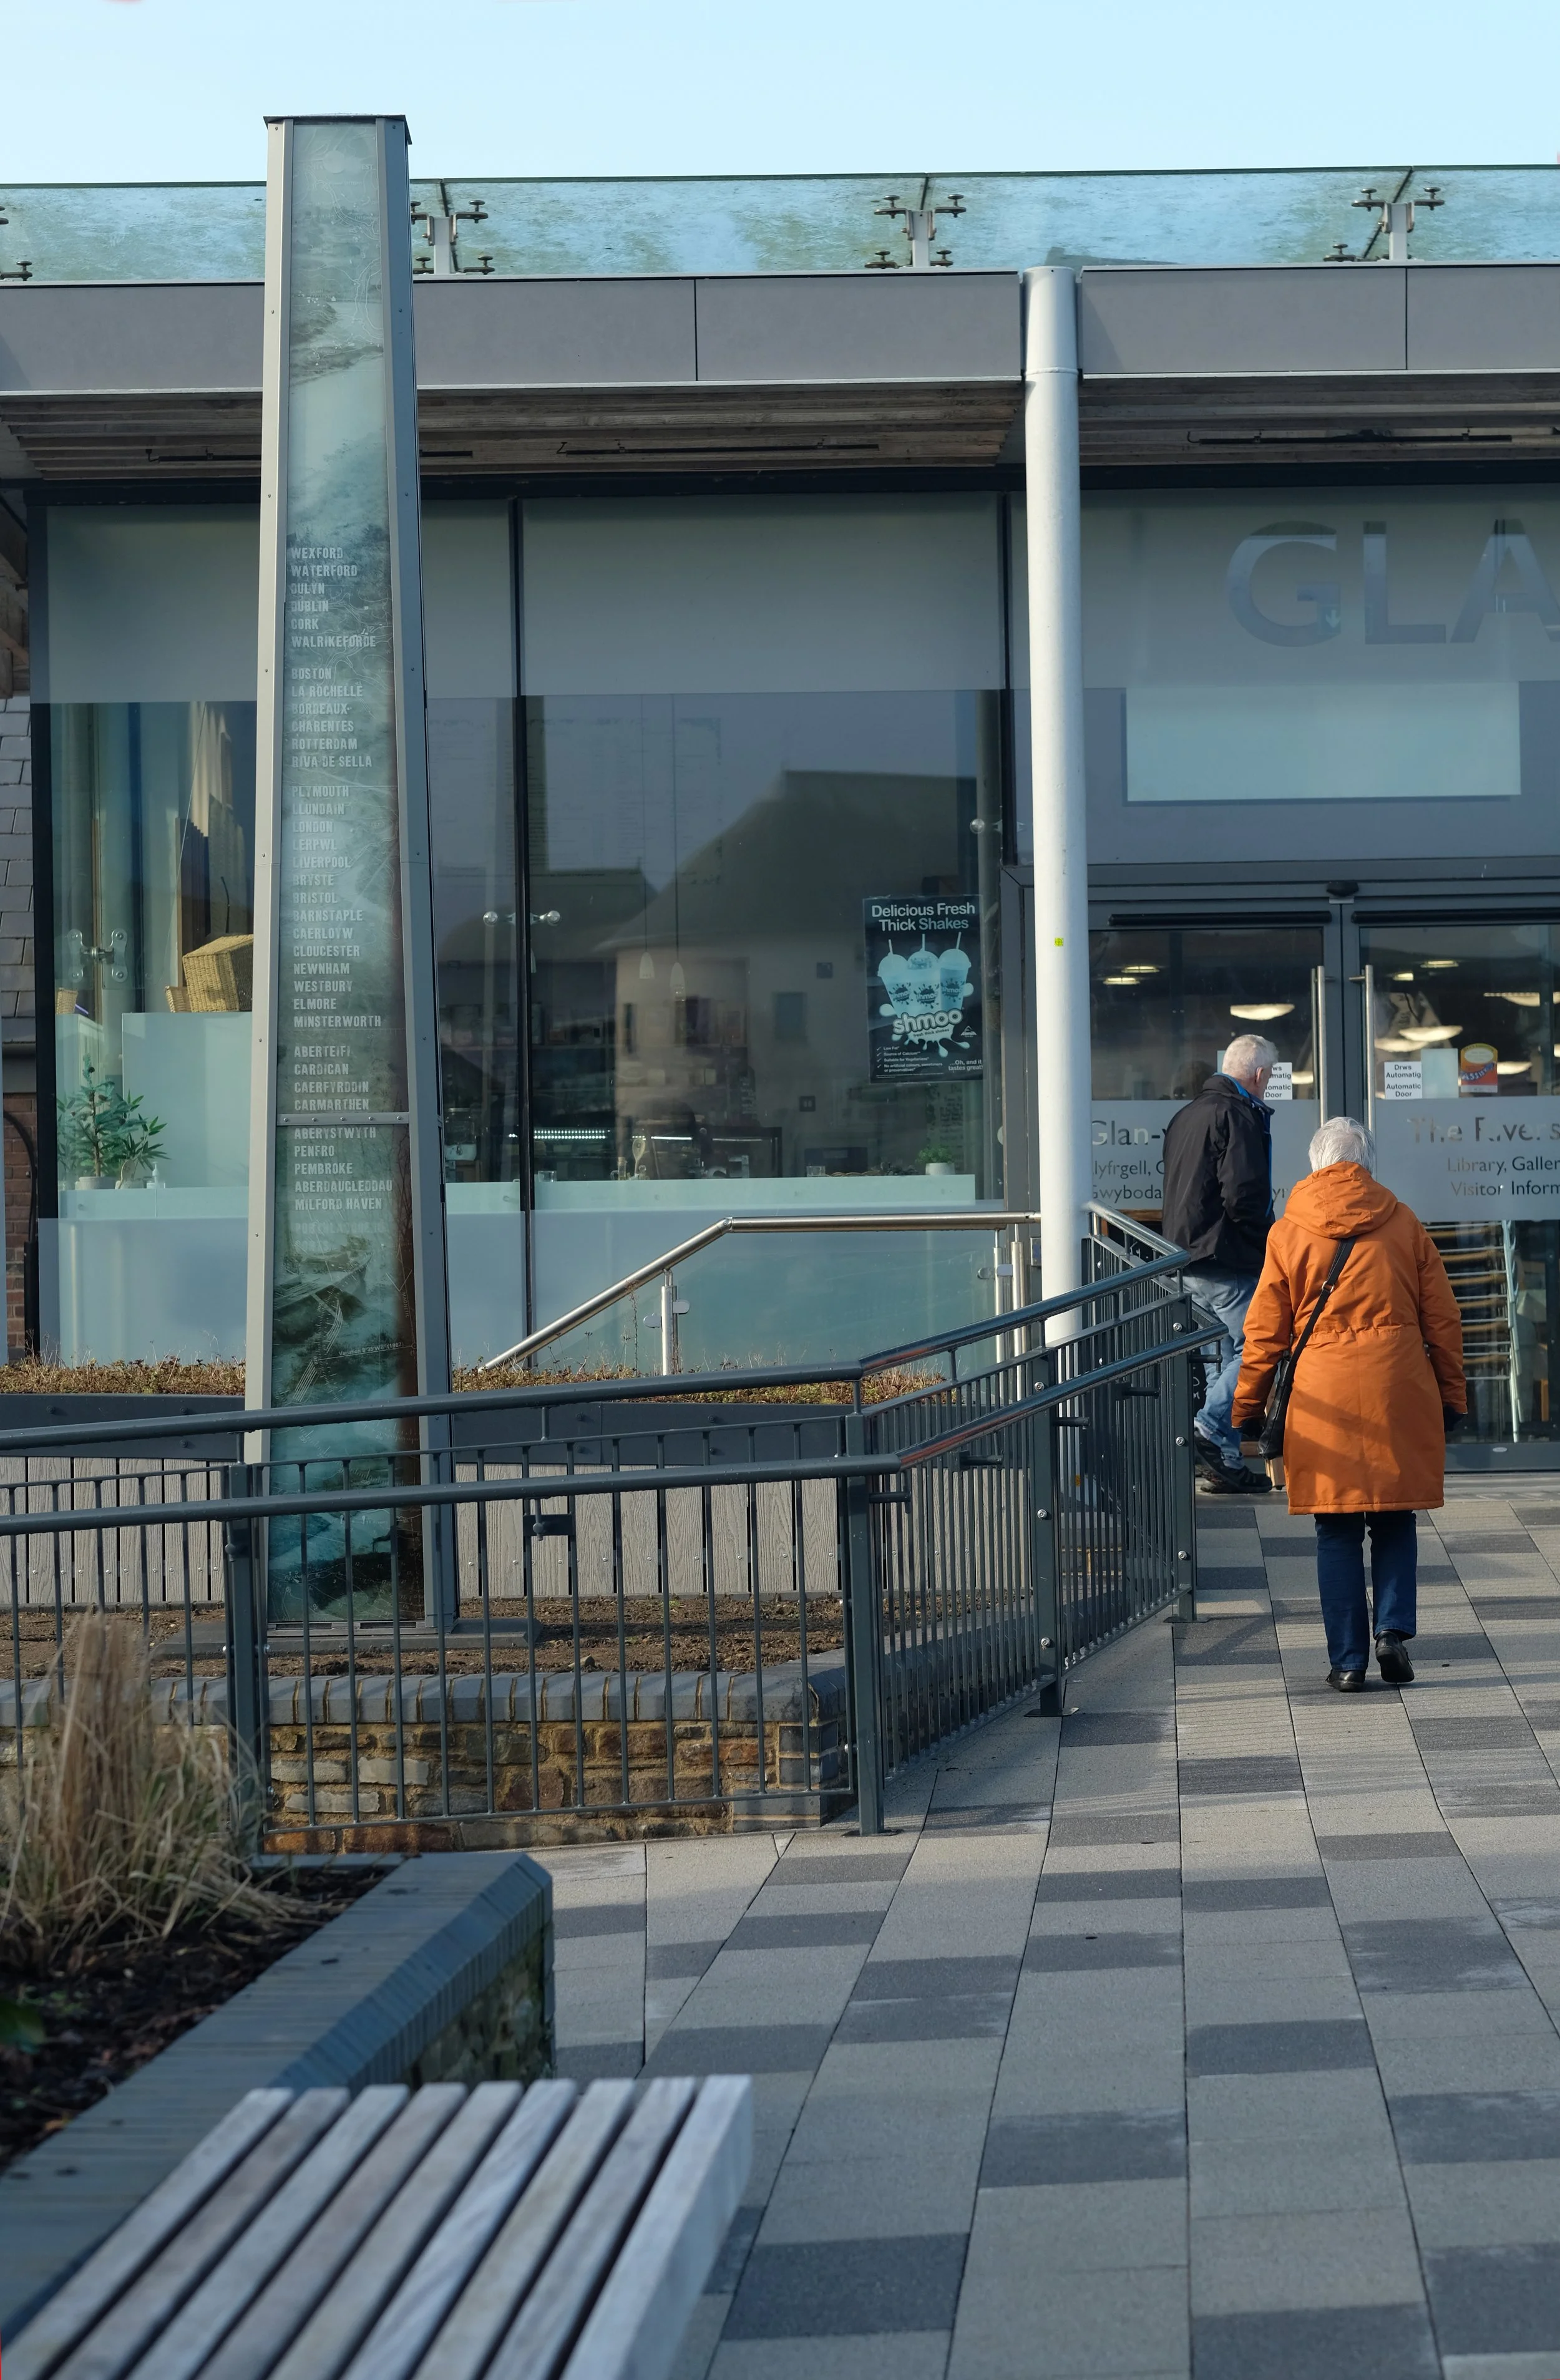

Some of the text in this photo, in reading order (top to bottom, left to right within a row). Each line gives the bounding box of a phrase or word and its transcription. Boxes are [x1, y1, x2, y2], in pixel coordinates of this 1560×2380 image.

[291, 548, 343, 559] WEXFORD
[291, 565, 358, 576] WATERFORD
[291, 601, 328, 612] DUBLIN
[291, 618, 319, 629] CORK
[291, 636, 376, 647] WALRIKEFORDE
[291, 668, 331, 679] BOSTON
[292, 686, 363, 697] LA ROCHELLE
[292, 703, 348, 714] BORDEAUX
[292, 721, 354, 732] CHARENTES
[292, 739, 357, 750] ROTTERDAM
[323, 756, 334, 767] DE
[339, 755, 372, 767] SELLA
[292, 786, 349, 797] PLYMOUTH
[292, 804, 344, 815] LLUNDAIN
[293, 821, 333, 832] LONDON
[293, 839, 337, 850] LERPWL
[293, 857, 351, 868] LIVERPOOL
[293, 875, 334, 886] BRYSTE
[293, 892, 338, 903] BRISTOL
[872, 902, 975, 917] Delicious Fresh
[293, 910, 363, 921] BARNSTAPLE
[879, 918, 968, 931] Thick Shakes
[293, 928, 353, 939] CAERLOYW
[293, 945, 360, 957] GLOUCESTER
[294, 963, 349, 974] NEWNHAM
[294, 981, 352, 992] WESTBURY
[293, 998, 336, 1009] ELMORE
[294, 1016, 381, 1027] MINSTERWORTH
[893, 1008, 963, 1036] shmoo
[295, 1046, 350, 1057] ABERTEIFI
[295, 1064, 349, 1075] CARDIGAN
[295, 1081, 369, 1093] CAERFYRDDIN
[295, 1099, 369, 1111] CARMARTHEN
[295, 1127, 376, 1139] ABERYSTWYTH
[1092, 1120, 1166, 1145] Glan-
[1475, 1117, 1560, 1142] Rves
[295, 1145, 334, 1157] PENFRO
[295, 1163, 353, 1175] PEMBROKE
[1094, 1160, 1151, 1179] lyfrgell,
[1448, 1156, 1507, 1175] Library,
[295, 1180, 392, 1193] ABERDAUGLEDDAU
[1450, 1181, 1502, 1197] Visitor
[295, 1198, 382, 1210] MILFORD HAVEN
